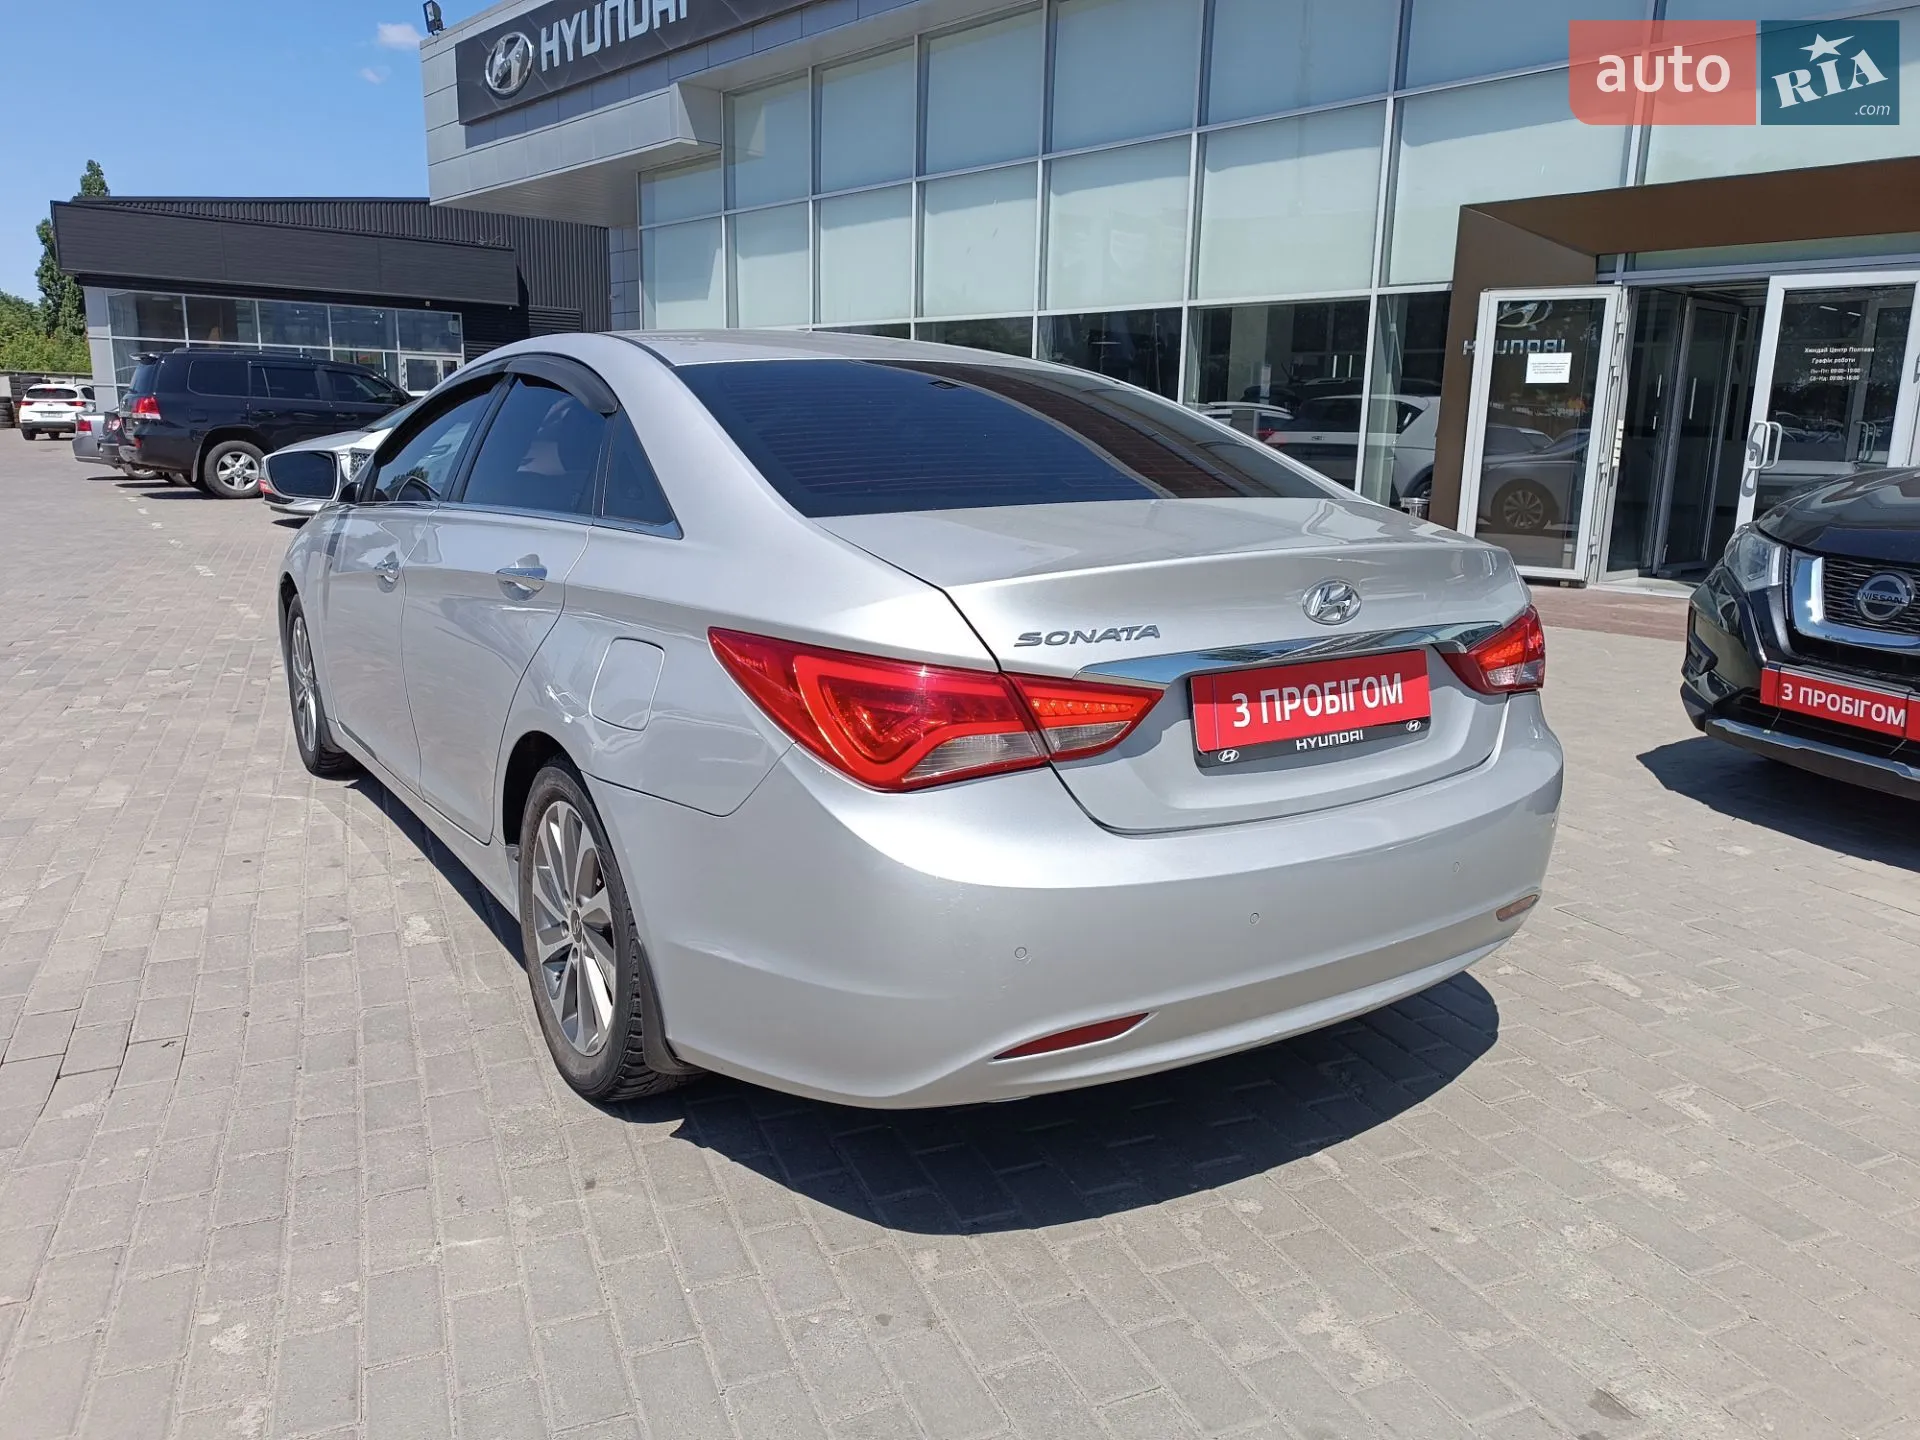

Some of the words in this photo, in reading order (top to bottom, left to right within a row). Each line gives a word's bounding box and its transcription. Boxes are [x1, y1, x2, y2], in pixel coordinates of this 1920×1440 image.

[1463, 339, 1565, 355] HUNDAI
[1861, 592, 1903, 605] NISSAN
[1014, 624, 1160, 647] SONATA
[1260, 672, 1404, 724] ПРОБІГОМ
[1799, 686, 1907, 728] ПРОБІГОМ
[1296, 730, 1364, 751] HYUNDAI
